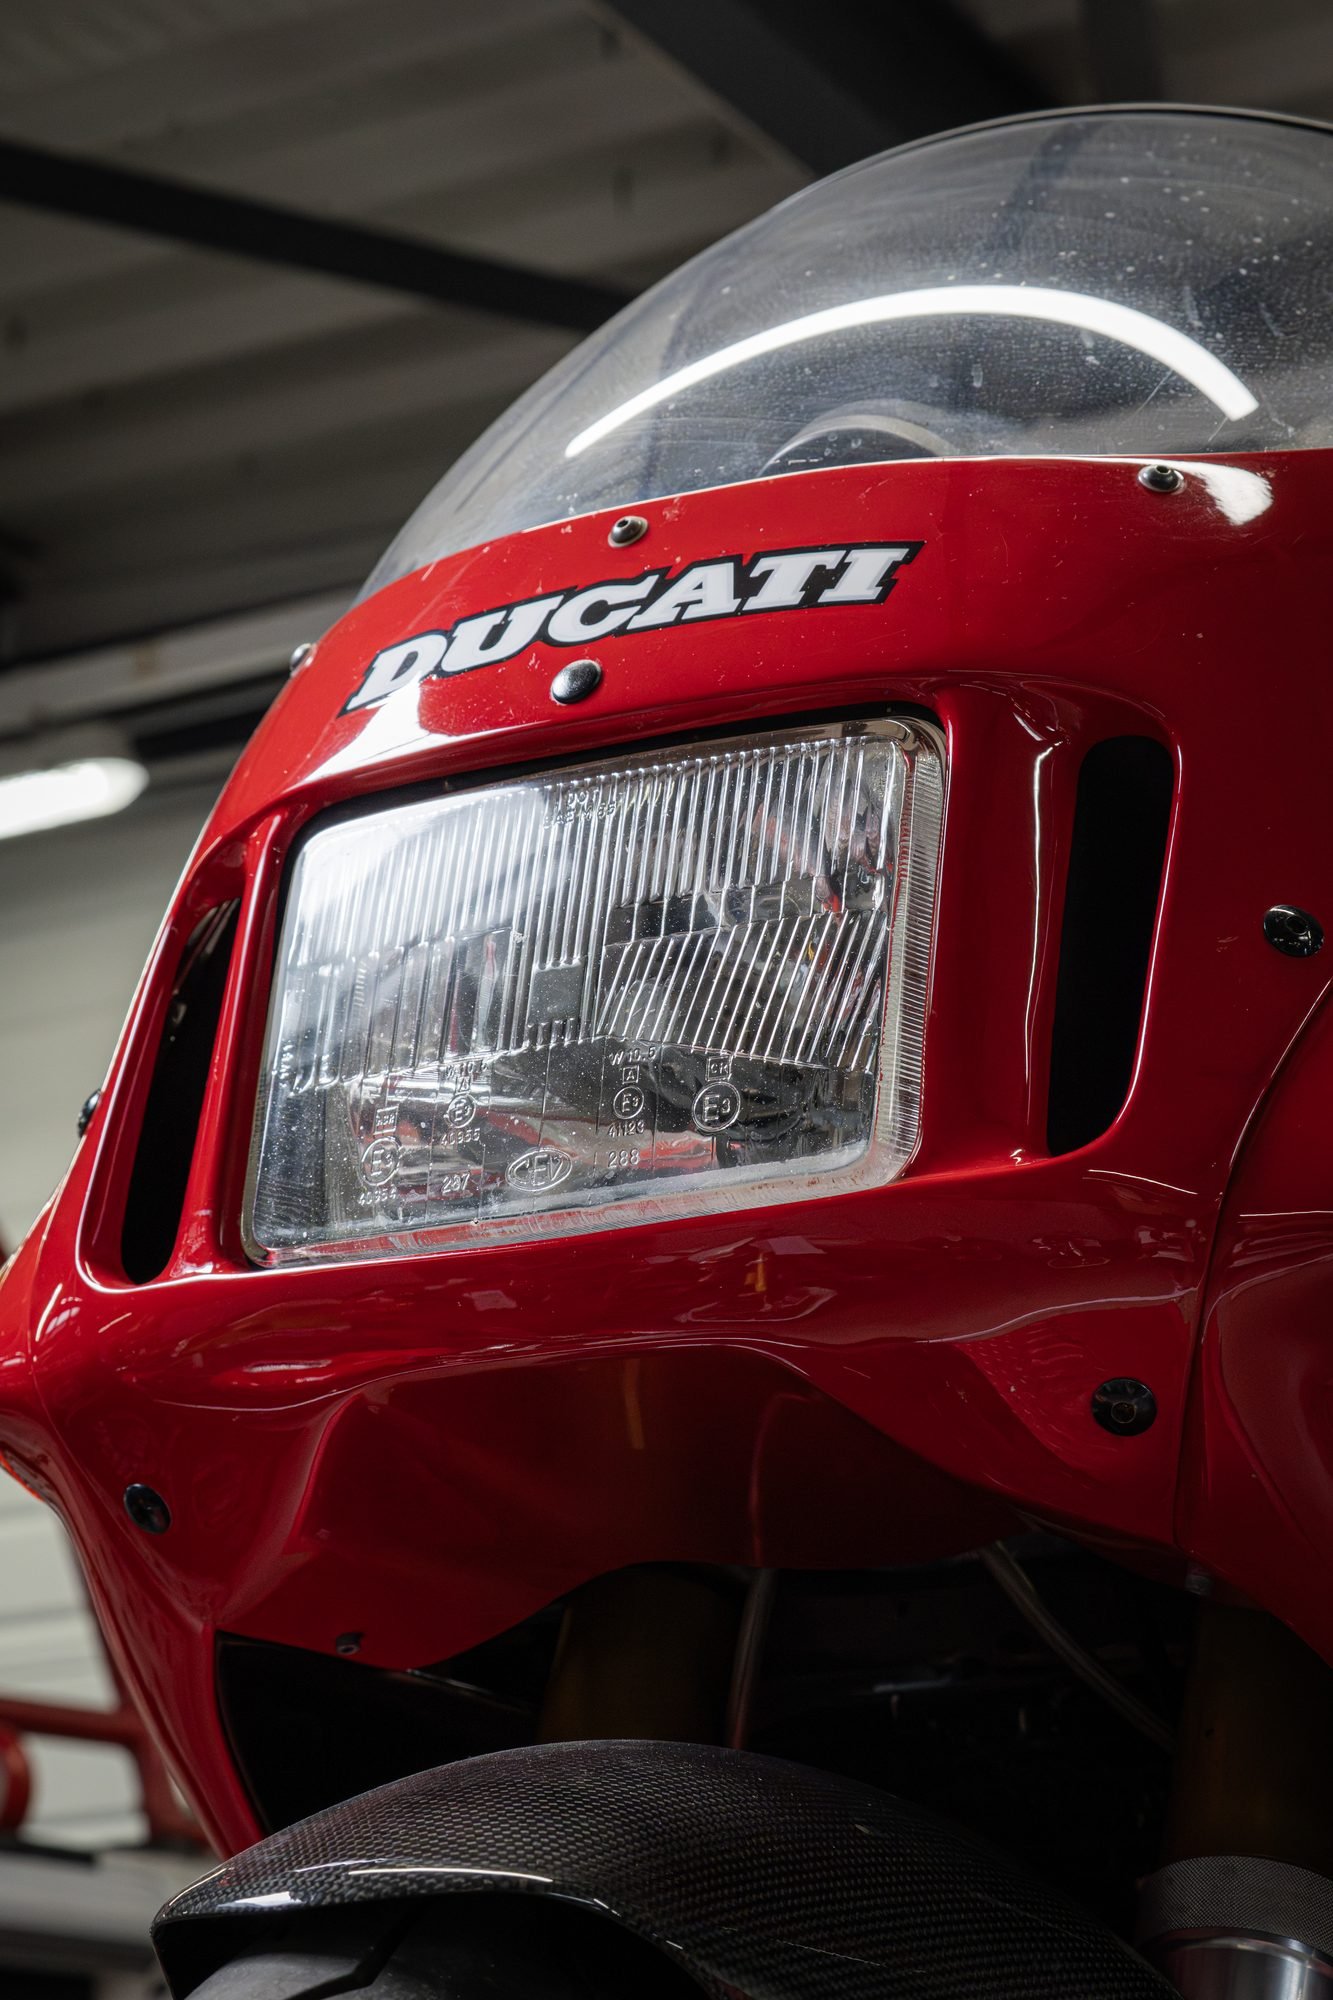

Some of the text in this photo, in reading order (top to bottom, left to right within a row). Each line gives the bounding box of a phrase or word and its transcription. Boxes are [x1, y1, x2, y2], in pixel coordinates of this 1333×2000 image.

[340, 545, 915, 714] DUCATI
[567, 788, 601, 808] DOT
[454, 1099, 471, 1122] E3
[622, 1094, 639, 1113] E3
[704, 1095, 731, 1122] E3
[370, 1149, 393, 1176] E3
[513, 1154, 564, 1186] CEV
[608, 1149, 640, 1168] 288
